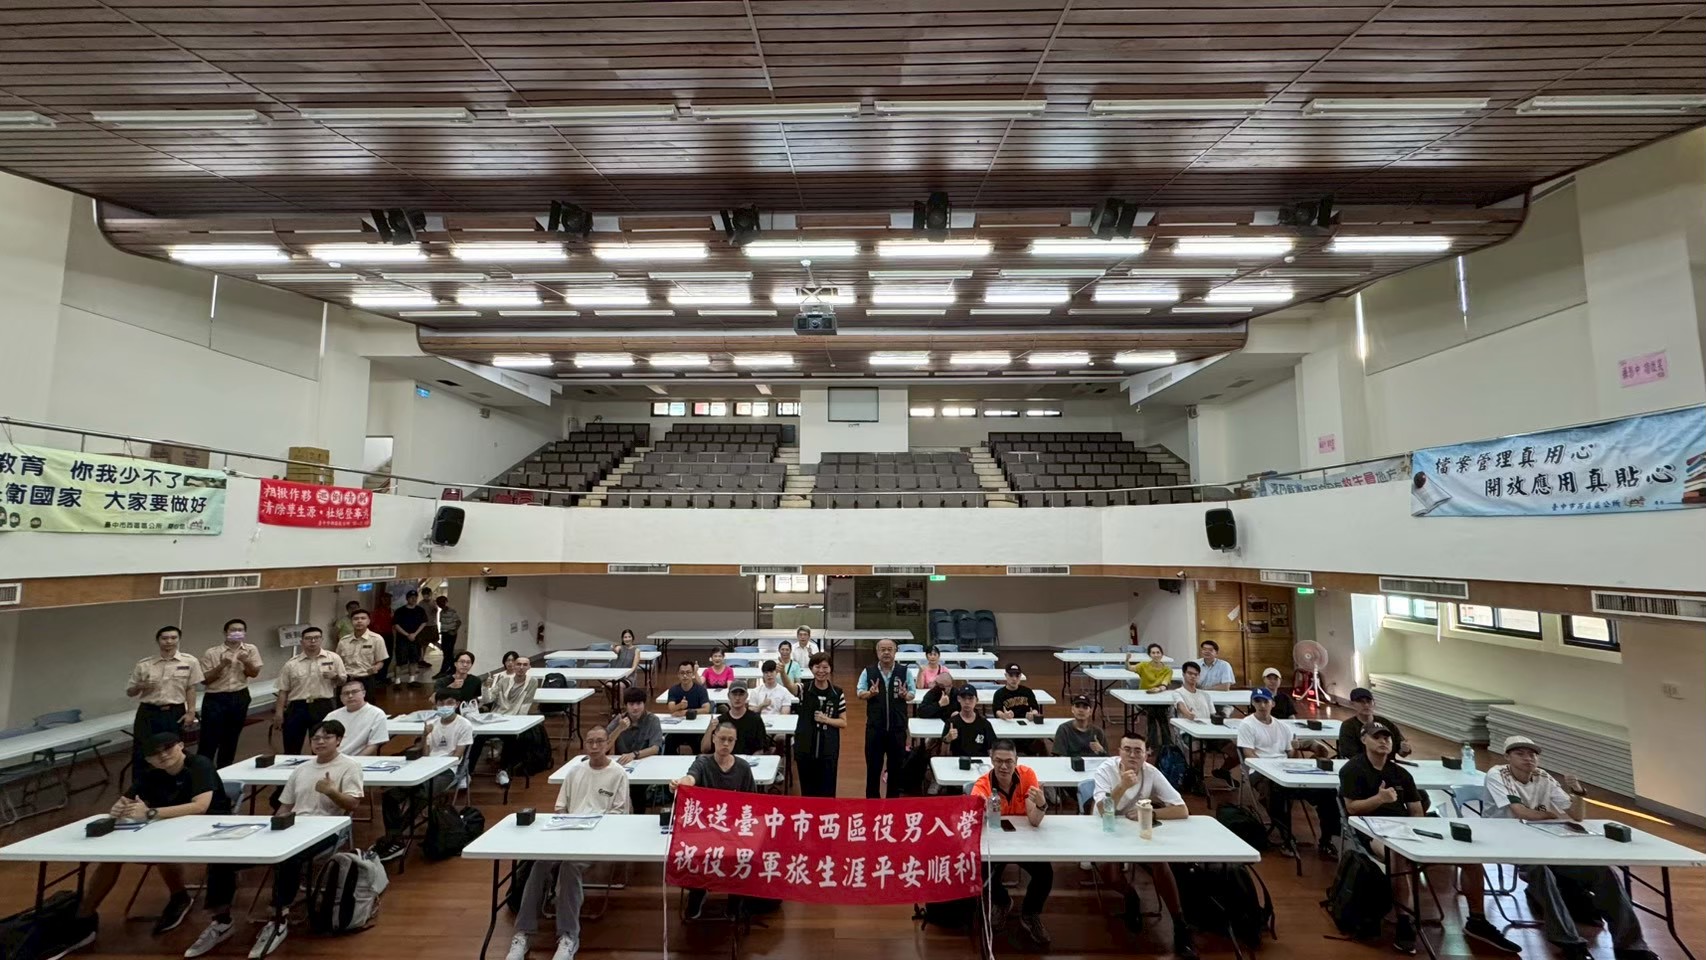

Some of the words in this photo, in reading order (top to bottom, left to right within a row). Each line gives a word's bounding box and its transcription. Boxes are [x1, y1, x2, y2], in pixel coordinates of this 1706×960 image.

[0, 452, 47, 477] 教育
[70, 460, 182, 489] 你我少不了
[1435, 444, 1595, 475] 檔案管理真用心
[0, 482, 82, 508] 衛國家
[103, 490, 208, 514] 大家要做好
[1484, 464, 1675, 498] 開放應用真貼心
[680, 797, 979, 844] 歡送臺中市西區役男入營
[672, 841, 977, 890] 祝役男軍旅生涯平安順利
